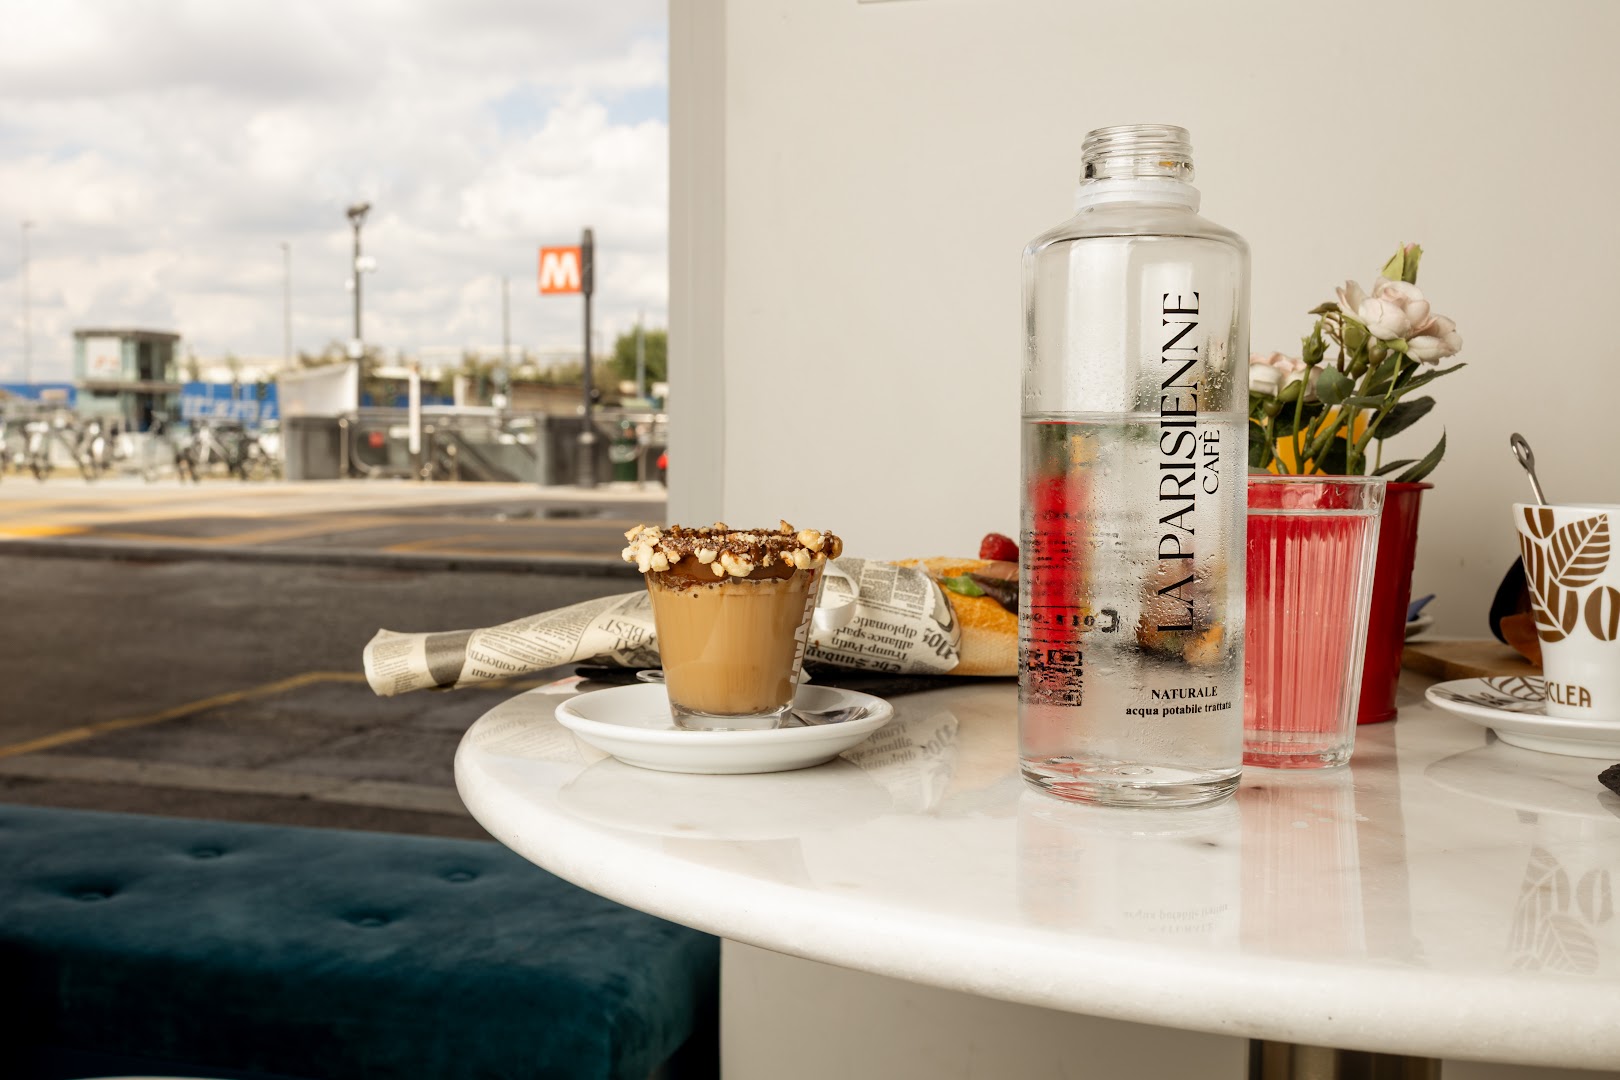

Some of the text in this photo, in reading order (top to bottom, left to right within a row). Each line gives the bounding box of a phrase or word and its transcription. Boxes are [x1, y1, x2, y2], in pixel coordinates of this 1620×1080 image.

[540, 252, 580, 289] M
[1157, 291, 1199, 631] LA PARISIENNE
[1198, 429, 1220, 495] CAFÈ
[853, 615, 918, 639] diplomatic
[831, 636, 908, 662] Trump-Putin
[867, 633, 914, 650] alliance
[1151, 685, 1218, 700] NATURALE
[1125, 700, 1231, 718] acqua potabile trattata
